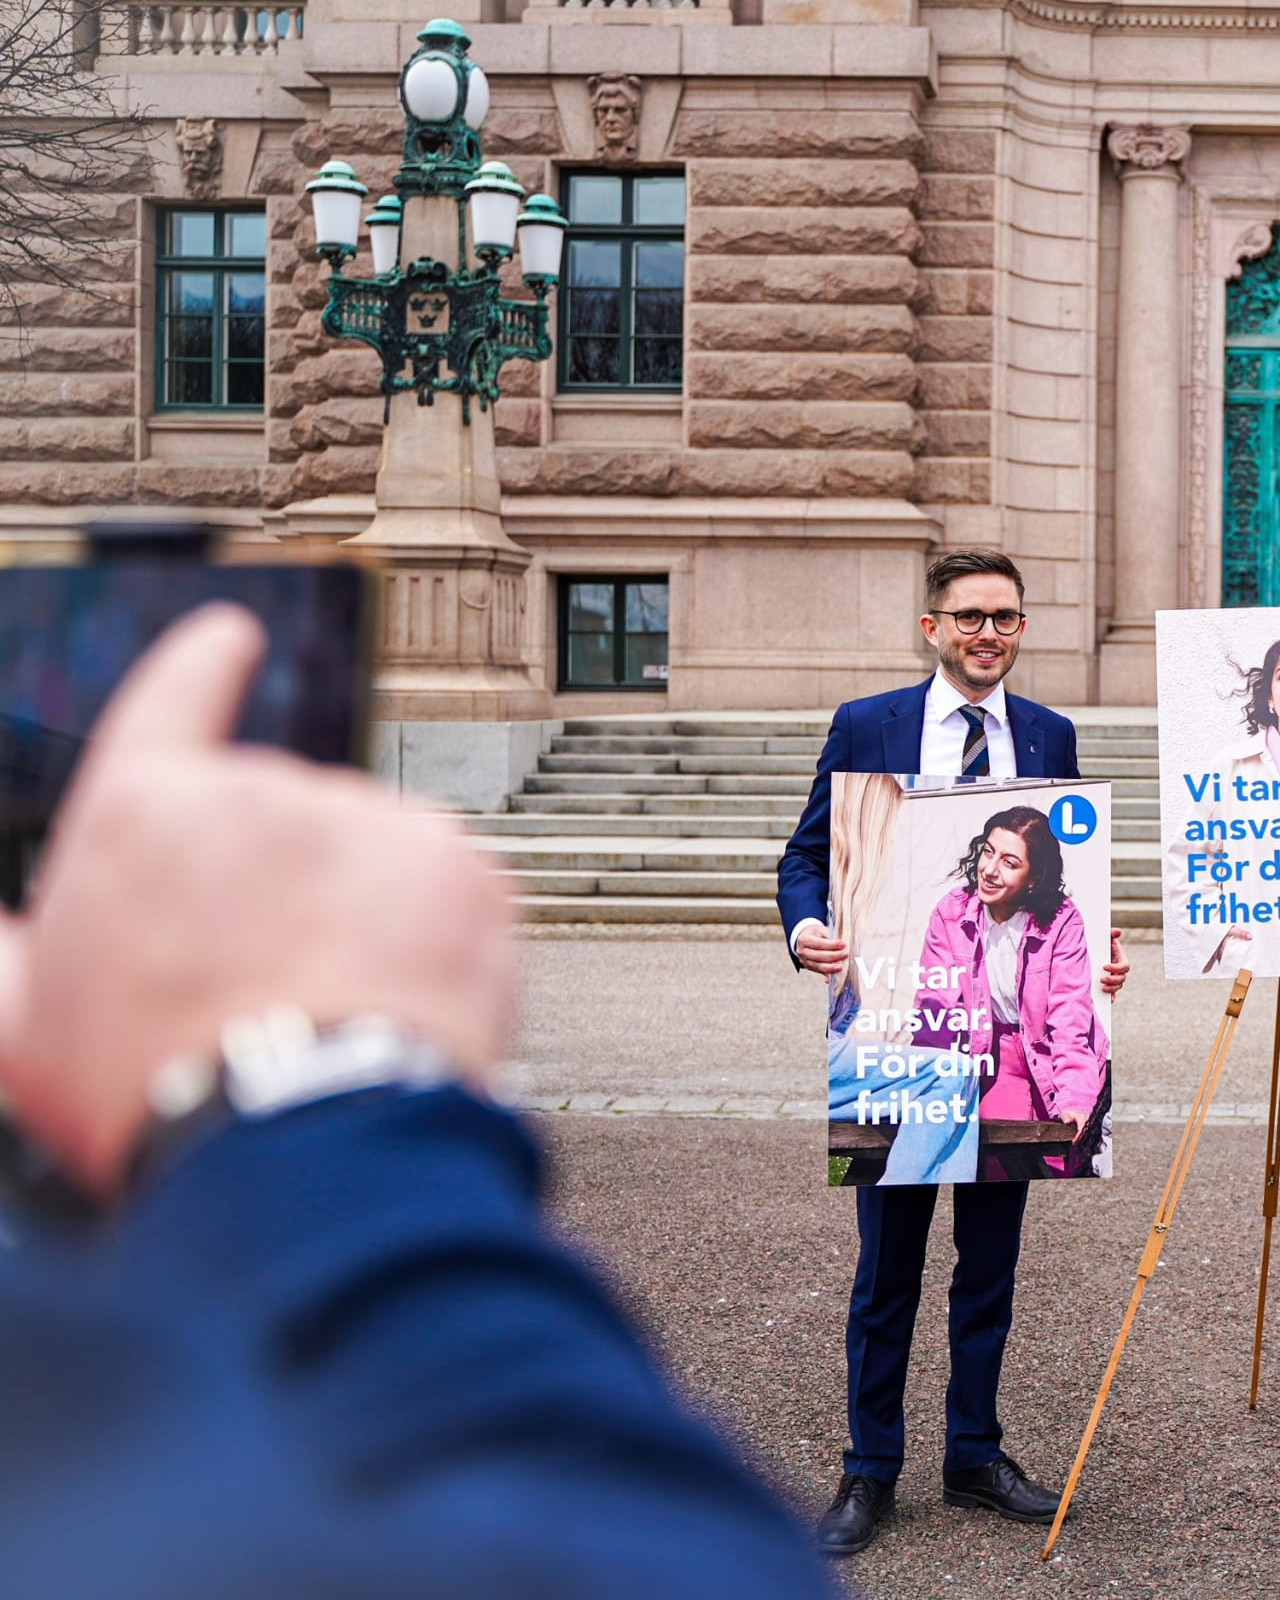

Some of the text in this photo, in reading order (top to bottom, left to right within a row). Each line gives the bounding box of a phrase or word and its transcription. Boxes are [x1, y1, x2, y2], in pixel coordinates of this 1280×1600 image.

[1183, 773, 1222, 803] Vi
[1062, 801, 1088, 835] L
[1187, 852, 1250, 883] För
[855, 956, 967, 990] Vi tar
[855, 1007, 993, 1032] ansvar.
[856, 1042, 995, 1079] För din
[853, 1089, 979, 1126] frihet.
